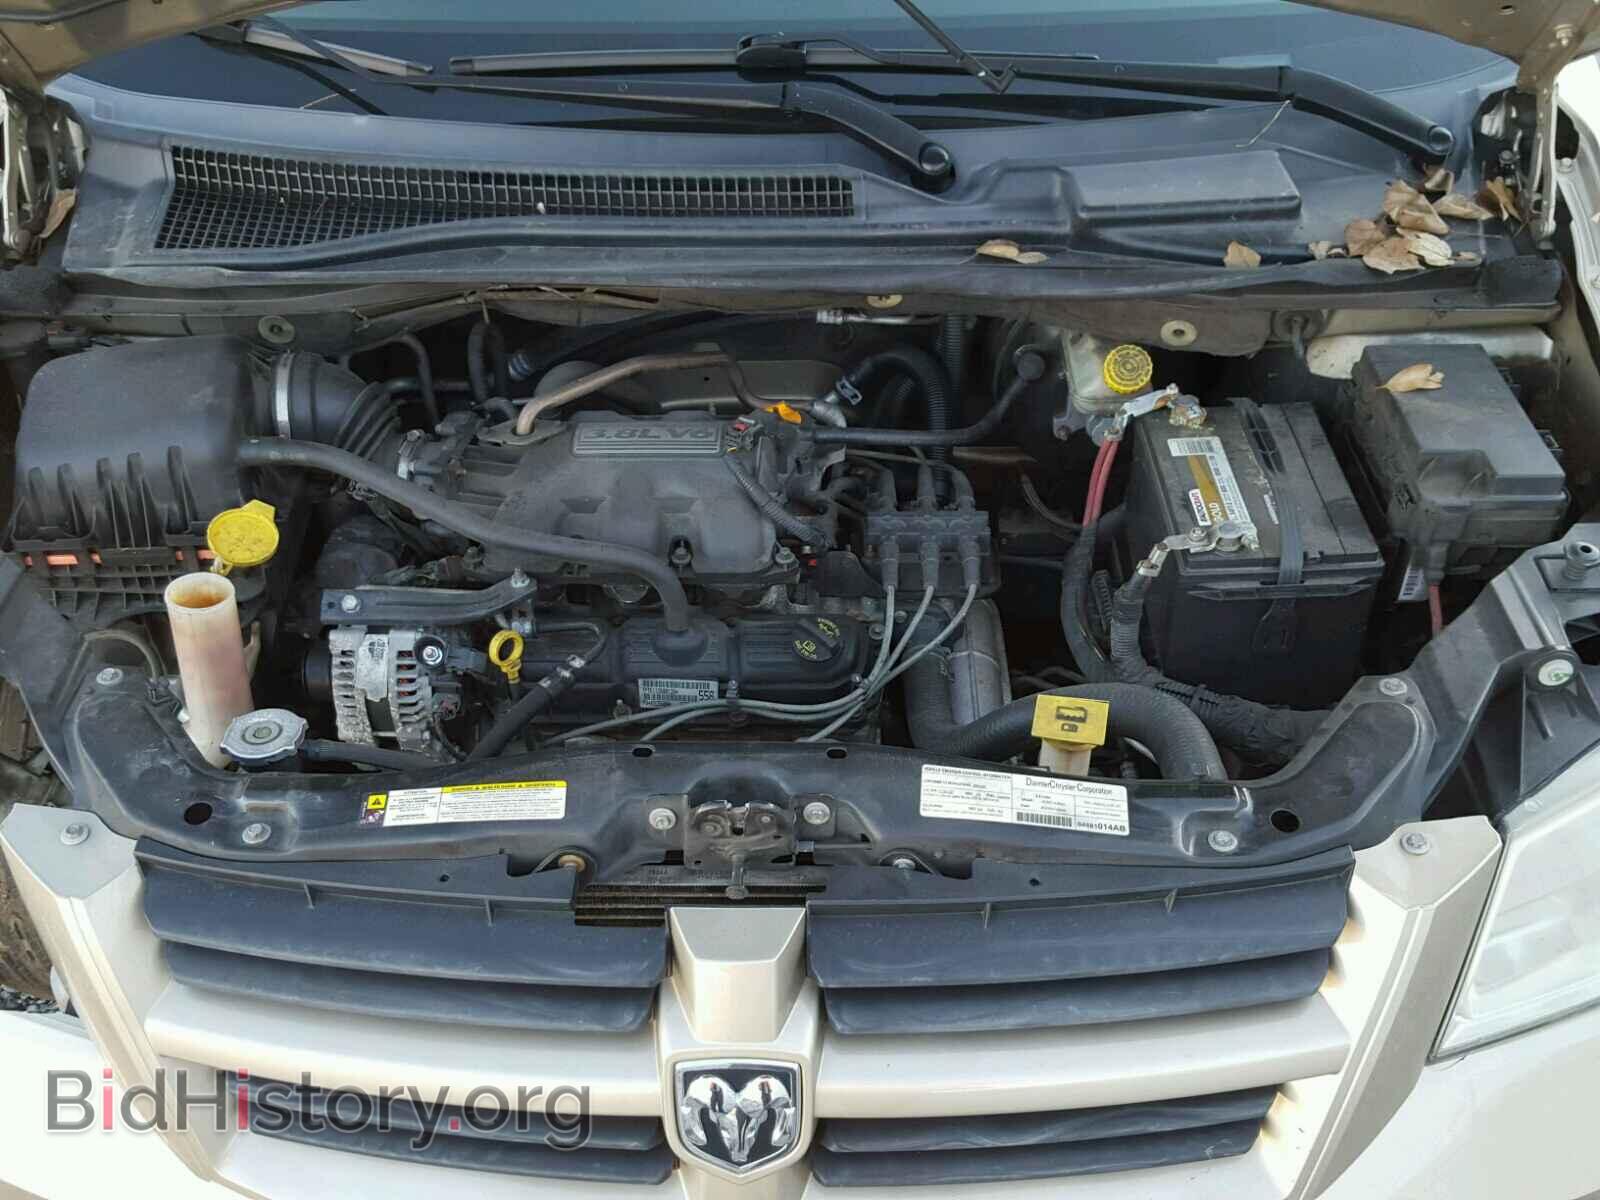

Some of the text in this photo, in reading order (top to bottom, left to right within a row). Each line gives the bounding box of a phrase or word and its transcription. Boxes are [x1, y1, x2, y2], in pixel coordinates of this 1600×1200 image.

[667, 428, 714, 439] V6
[1025, 777, 1113, 795] DaimlerChrysler Corporation
